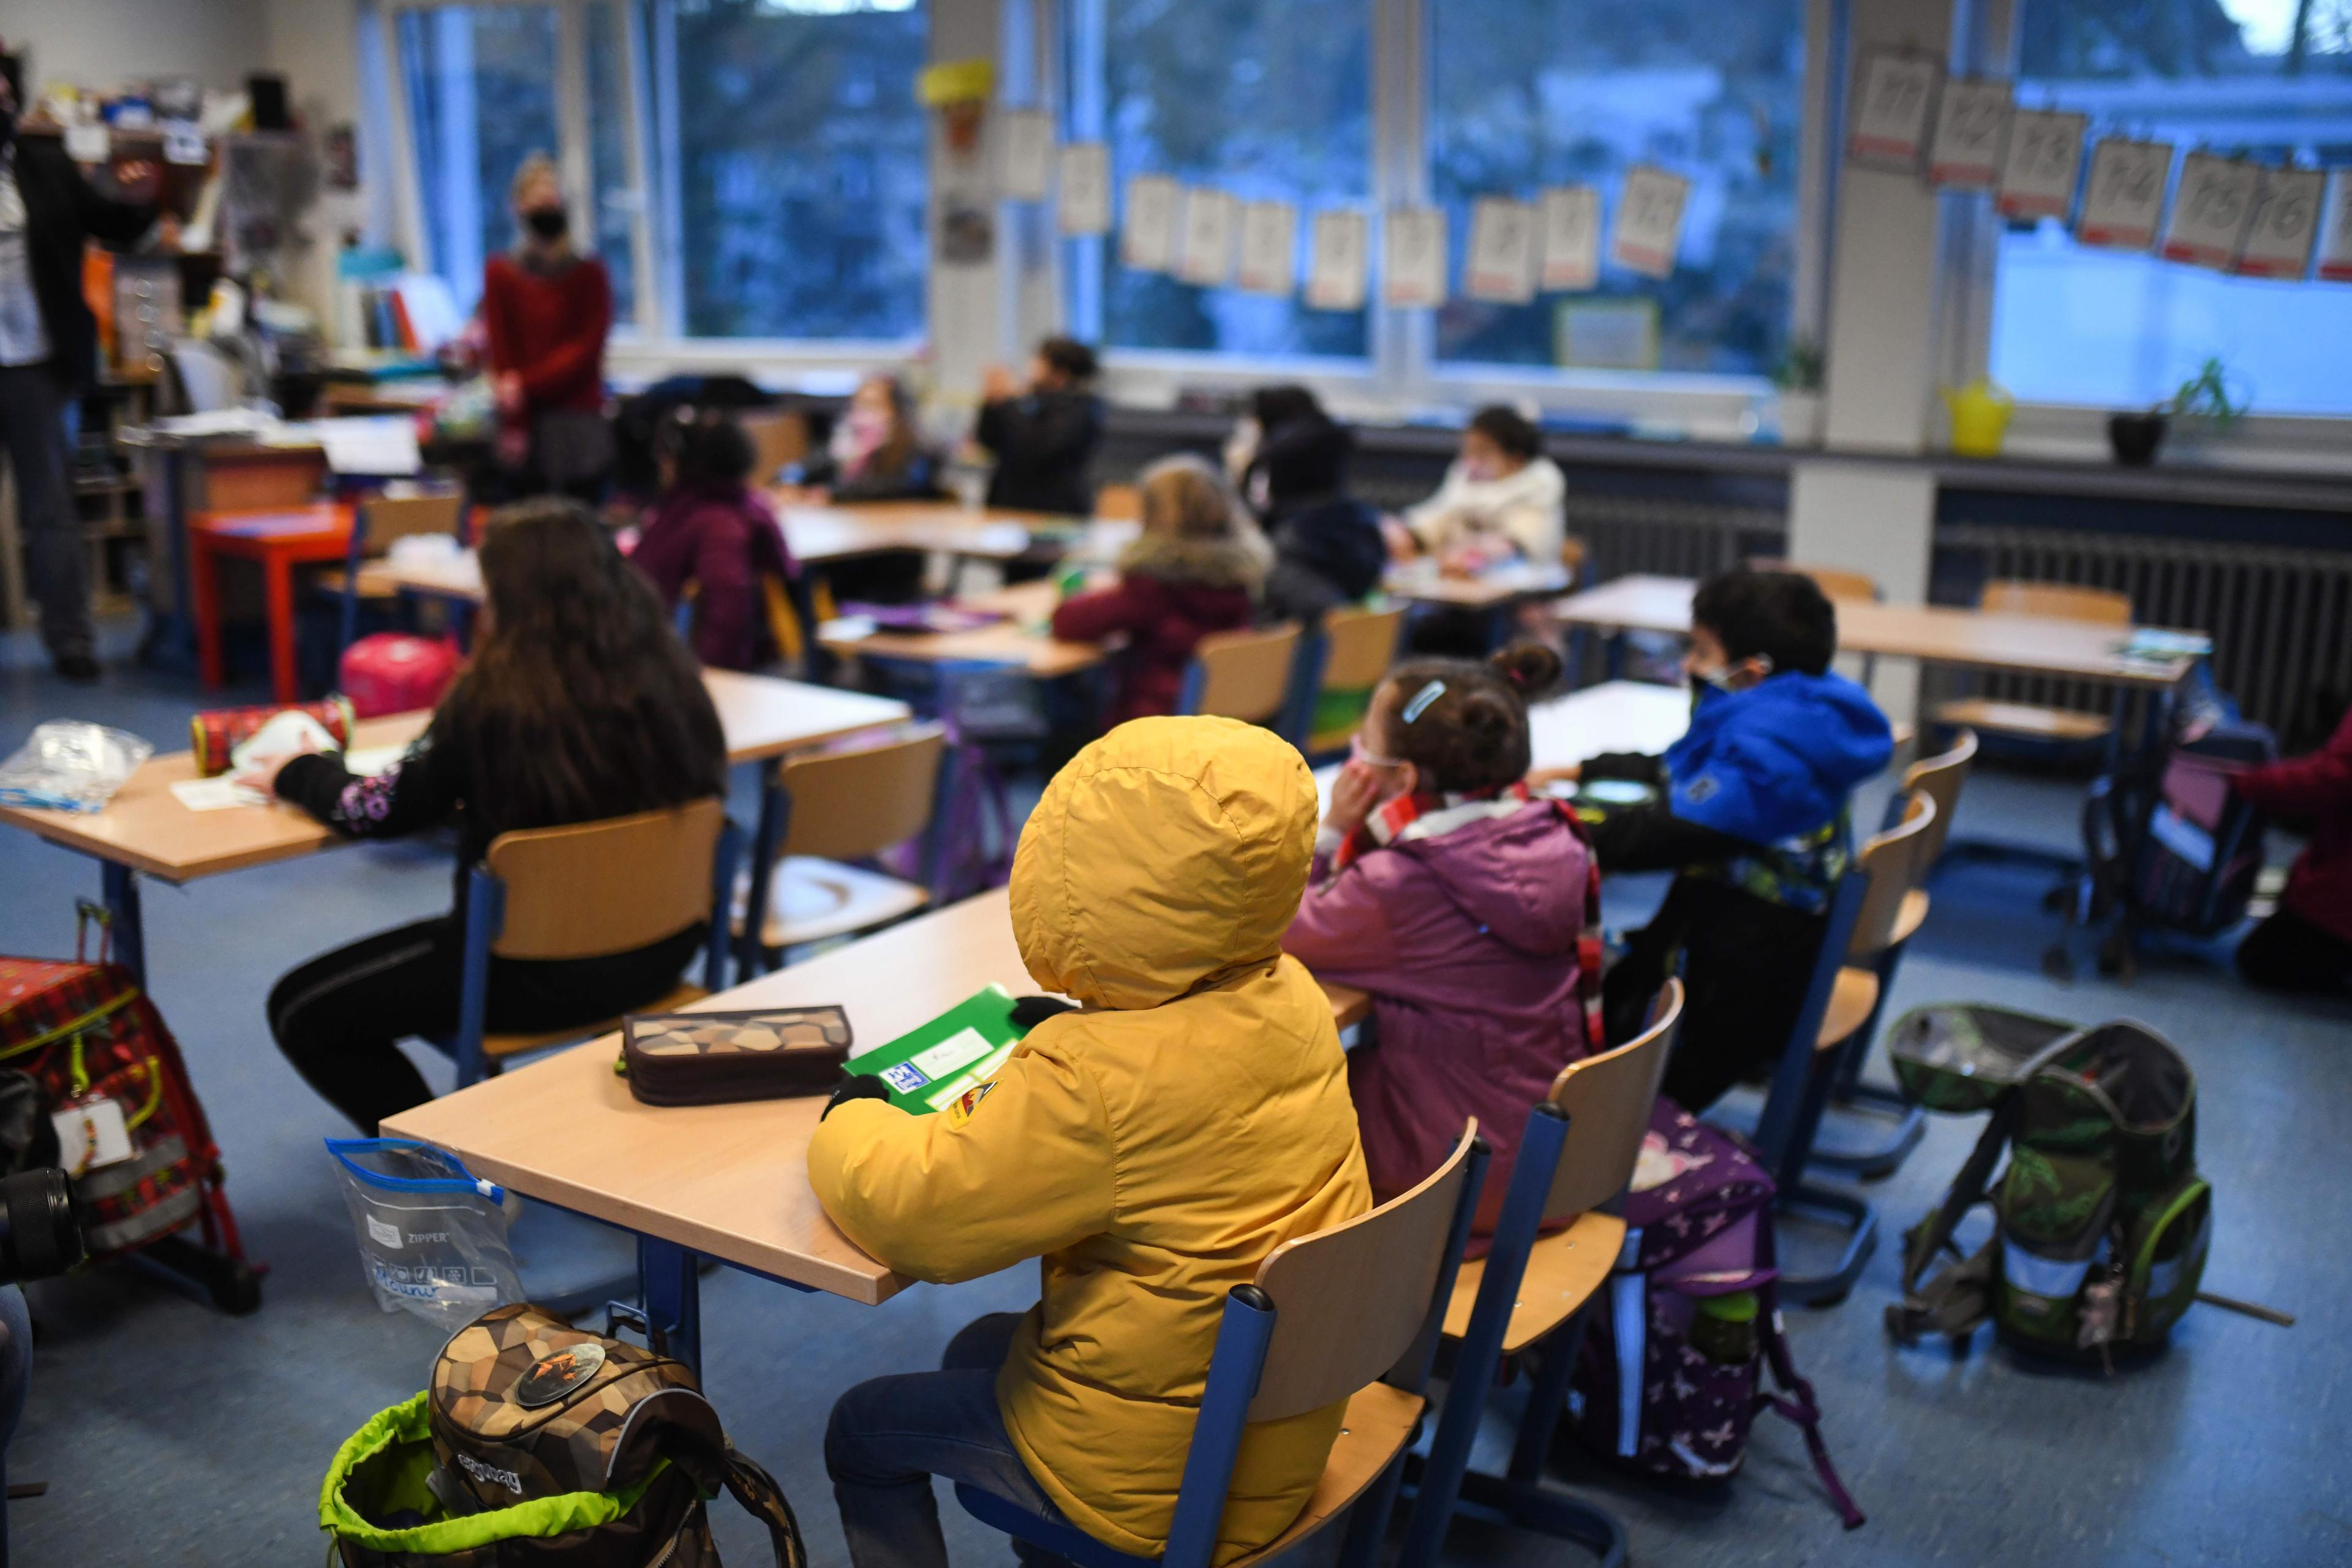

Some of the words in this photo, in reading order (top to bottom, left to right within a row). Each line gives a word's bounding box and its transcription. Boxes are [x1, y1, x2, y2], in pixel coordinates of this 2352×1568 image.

[2016, 125, 2073, 180] 13
[2101, 156, 2157, 209] 14
[2187, 173, 2247, 230] 15
[2249, 185, 2309, 240] 16
[407, 1232, 448, 1243] ZIPPER
